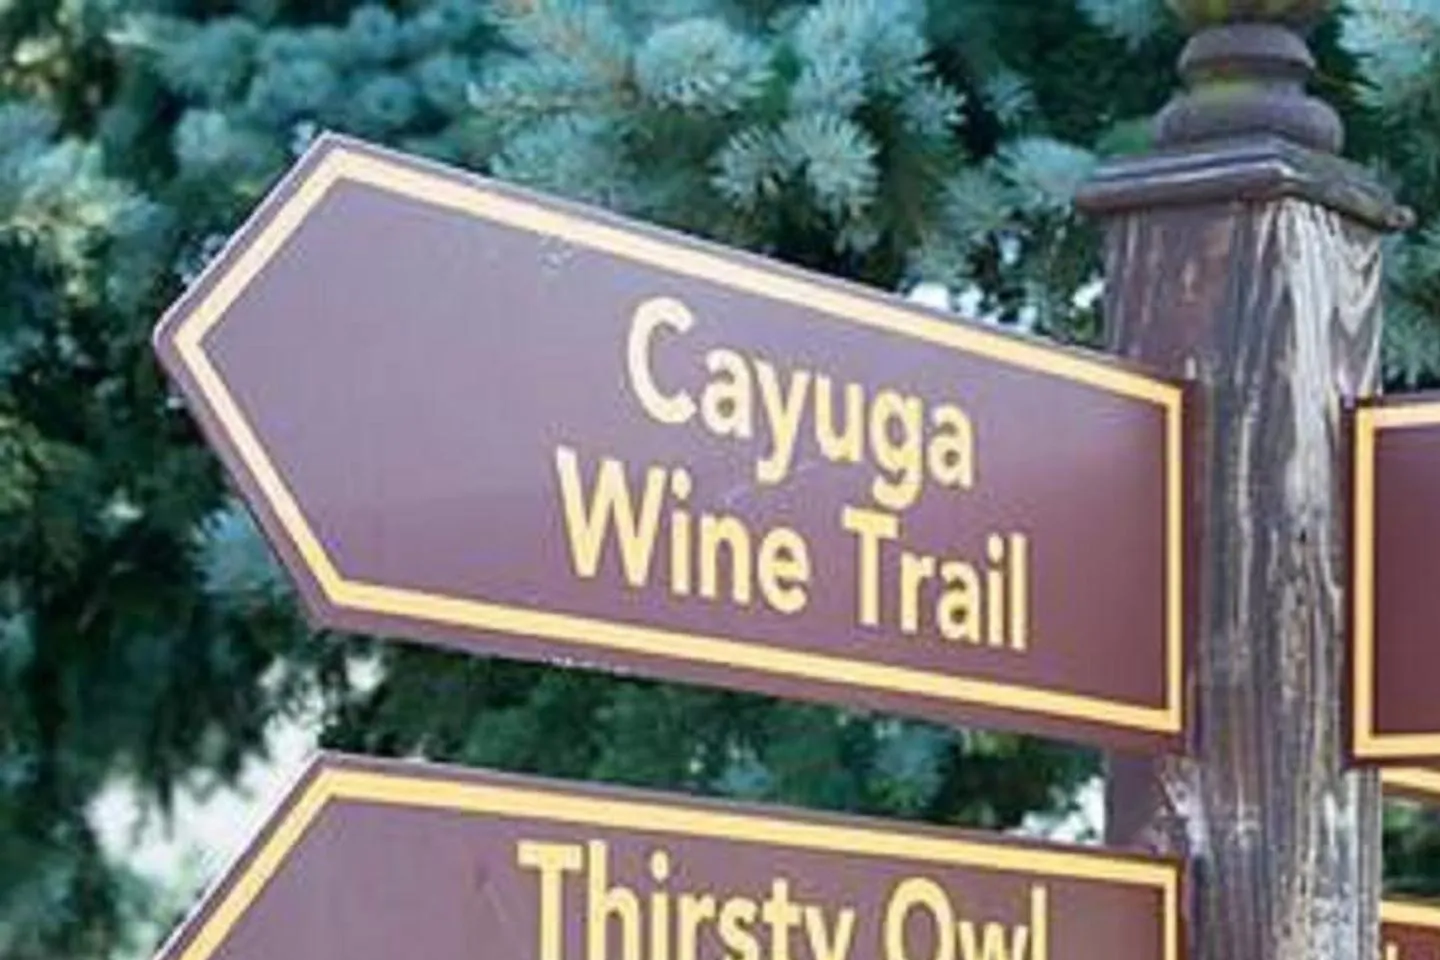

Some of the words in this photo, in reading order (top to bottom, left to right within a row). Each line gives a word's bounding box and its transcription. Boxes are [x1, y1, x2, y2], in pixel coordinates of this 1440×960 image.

[625, 296, 976, 513] Cayuga
[553, 442, 812, 616] Wine
[839, 503, 1030, 653] Trail
